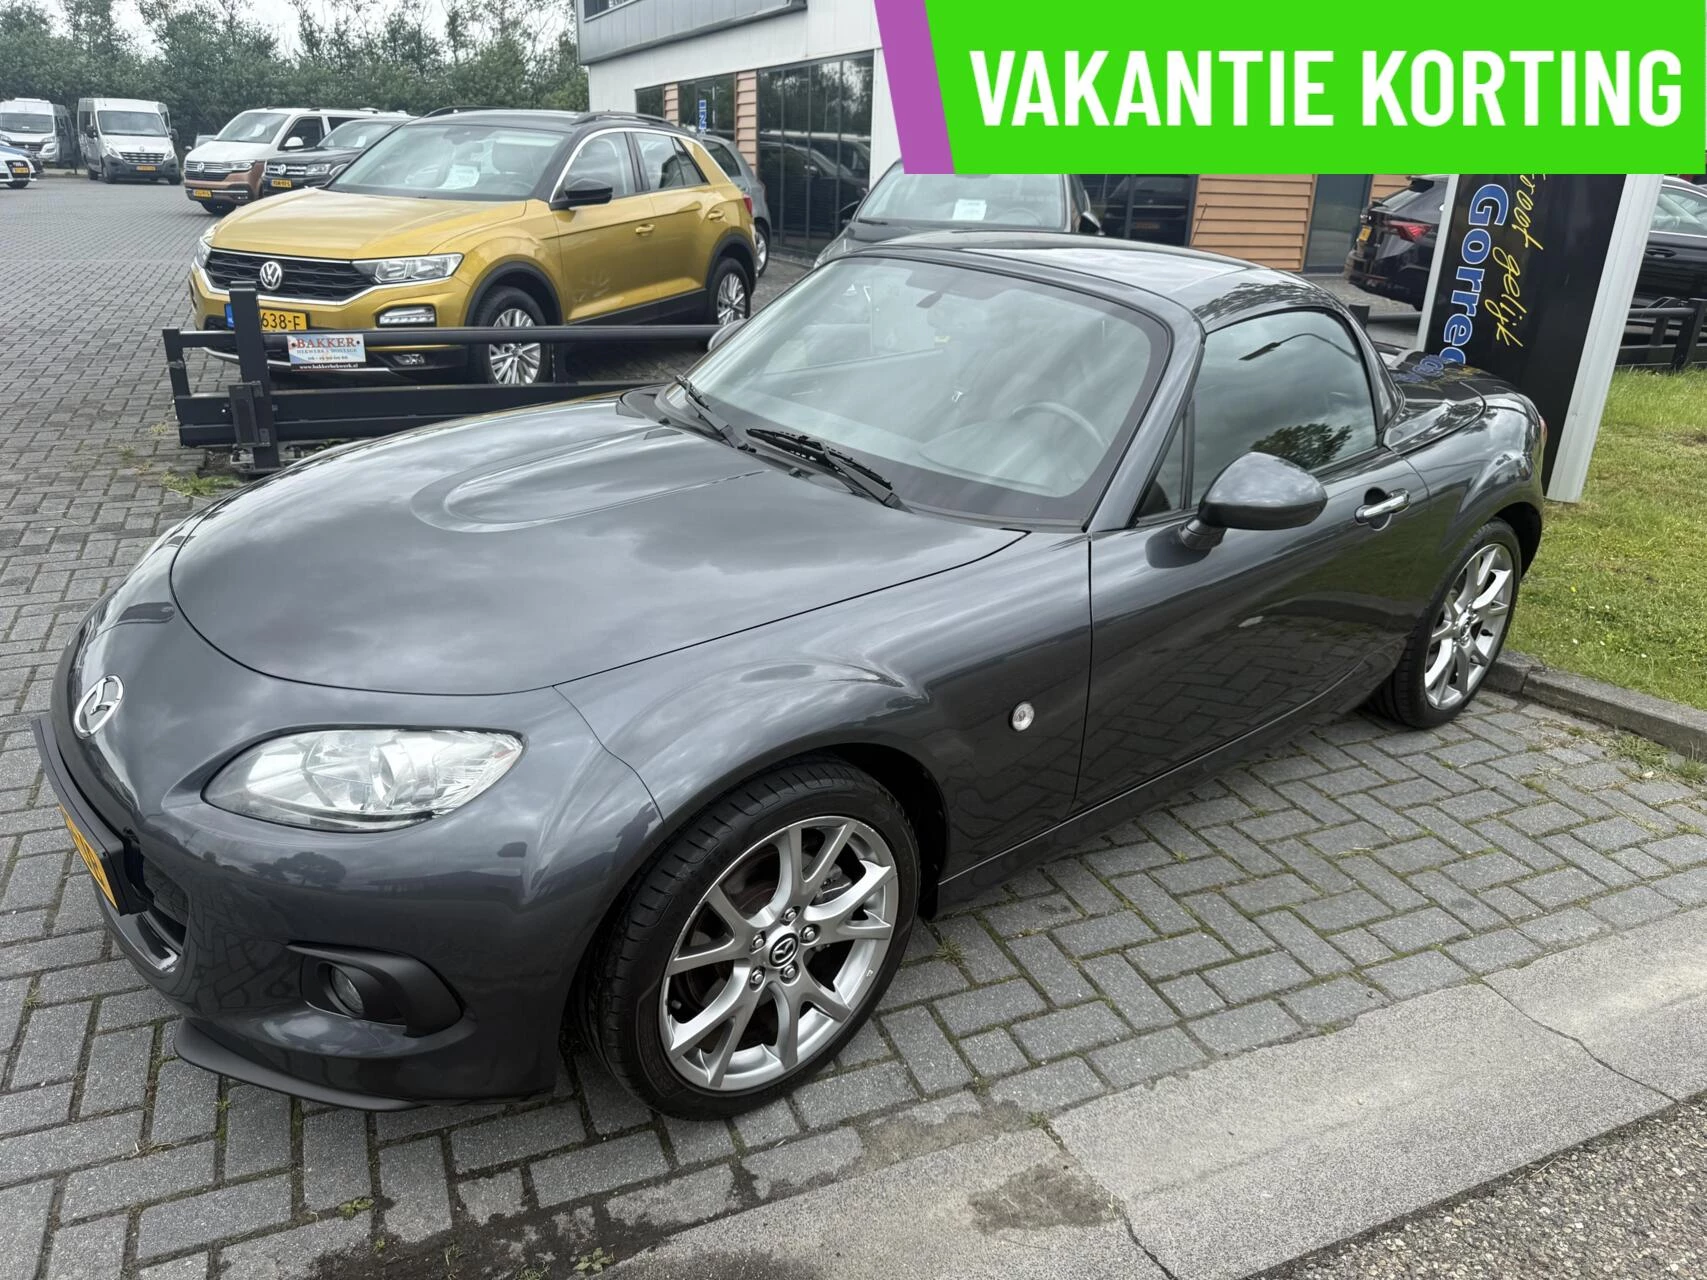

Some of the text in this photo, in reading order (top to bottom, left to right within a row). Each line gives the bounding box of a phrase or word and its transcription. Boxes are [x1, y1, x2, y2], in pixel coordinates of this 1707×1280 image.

[1484, 174, 1546, 347] root gelijk
[296, 337, 356, 349] BAKKER
